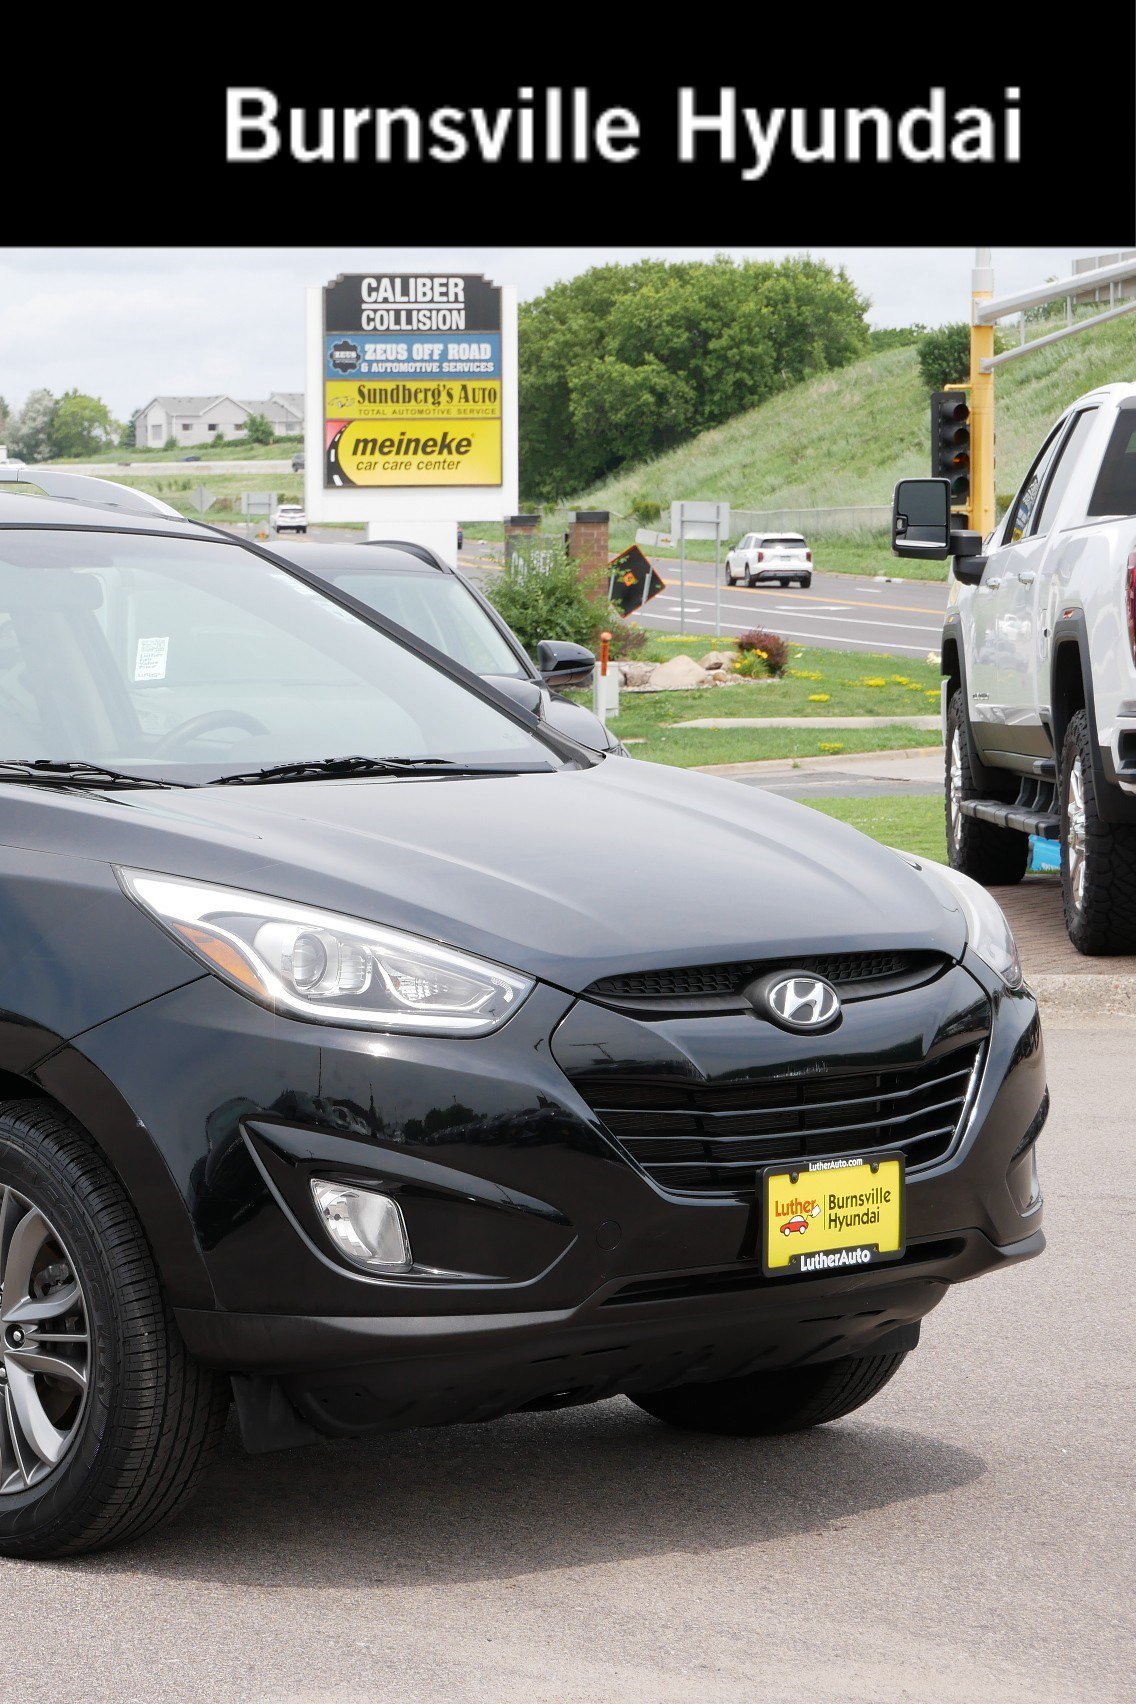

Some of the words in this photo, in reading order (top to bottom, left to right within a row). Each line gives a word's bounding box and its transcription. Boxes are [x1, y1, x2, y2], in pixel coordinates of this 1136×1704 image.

[361, 277, 465, 303] CALIBER
[361, 309, 466, 331] COLLISION
[364, 343, 408, 360] ZEUS
[412, 343, 444, 360] OFF
[447, 343, 492, 360] ROAD
[371, 362, 440, 373] AUTOMOTIVE
[442, 362, 494, 372] SERVICES
[357, 383, 454, 407] Sundberg's
[351, 432, 472, 456] meineke
[356, 461, 378, 471] car
[382, 461, 412, 471] care
[416, 460, 461, 471] center
[808, 1158, 863, 1172] LutherAuto.com
[775, 1198, 817, 1217] Luther
[828, 1187, 892, 1211] Burnsville
[828, 1207, 881, 1232] Hyundai
[800, 1247, 872, 1272] LutherAuto
